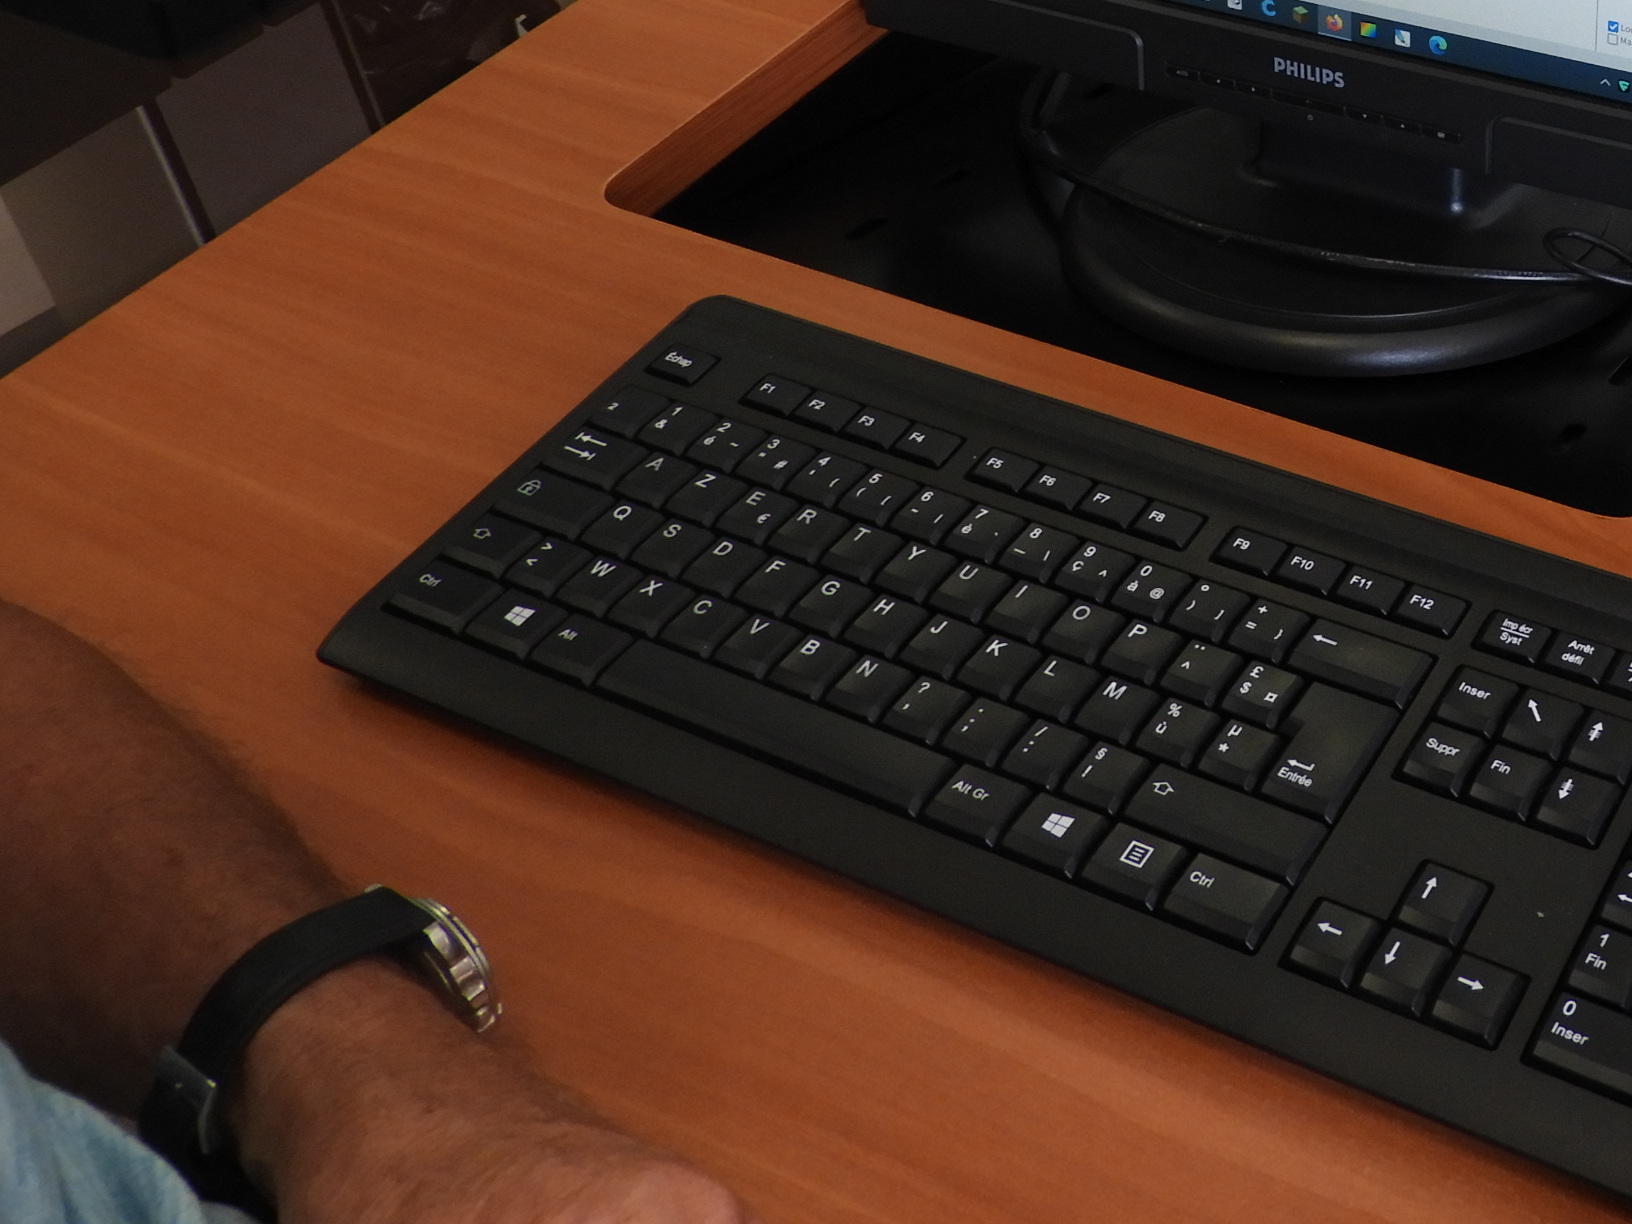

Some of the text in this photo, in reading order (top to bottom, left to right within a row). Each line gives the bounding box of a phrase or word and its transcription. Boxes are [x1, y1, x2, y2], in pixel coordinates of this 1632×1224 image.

[1273, 56, 1345, 89] PHILIPS
[759, 382, 777, 395] F1
[1409, 593, 1435, 611] F12
[1499, 631, 1523, 646] Syst
[1567, 639, 1596, 656] Arrêt
[1561, 650, 1585, 666] défil
[1458, 681, 1492, 701] Inser
[1425, 737, 1461, 757] Suppr
[1490, 759, 1512, 775] Fin
[1277, 766, 1313, 788] Entrée
[951, 779, 991, 803] Alt Gr
[1189, 869, 1215, 888] Ctrl
[1550, 1021, 1590, 1047] Inser
